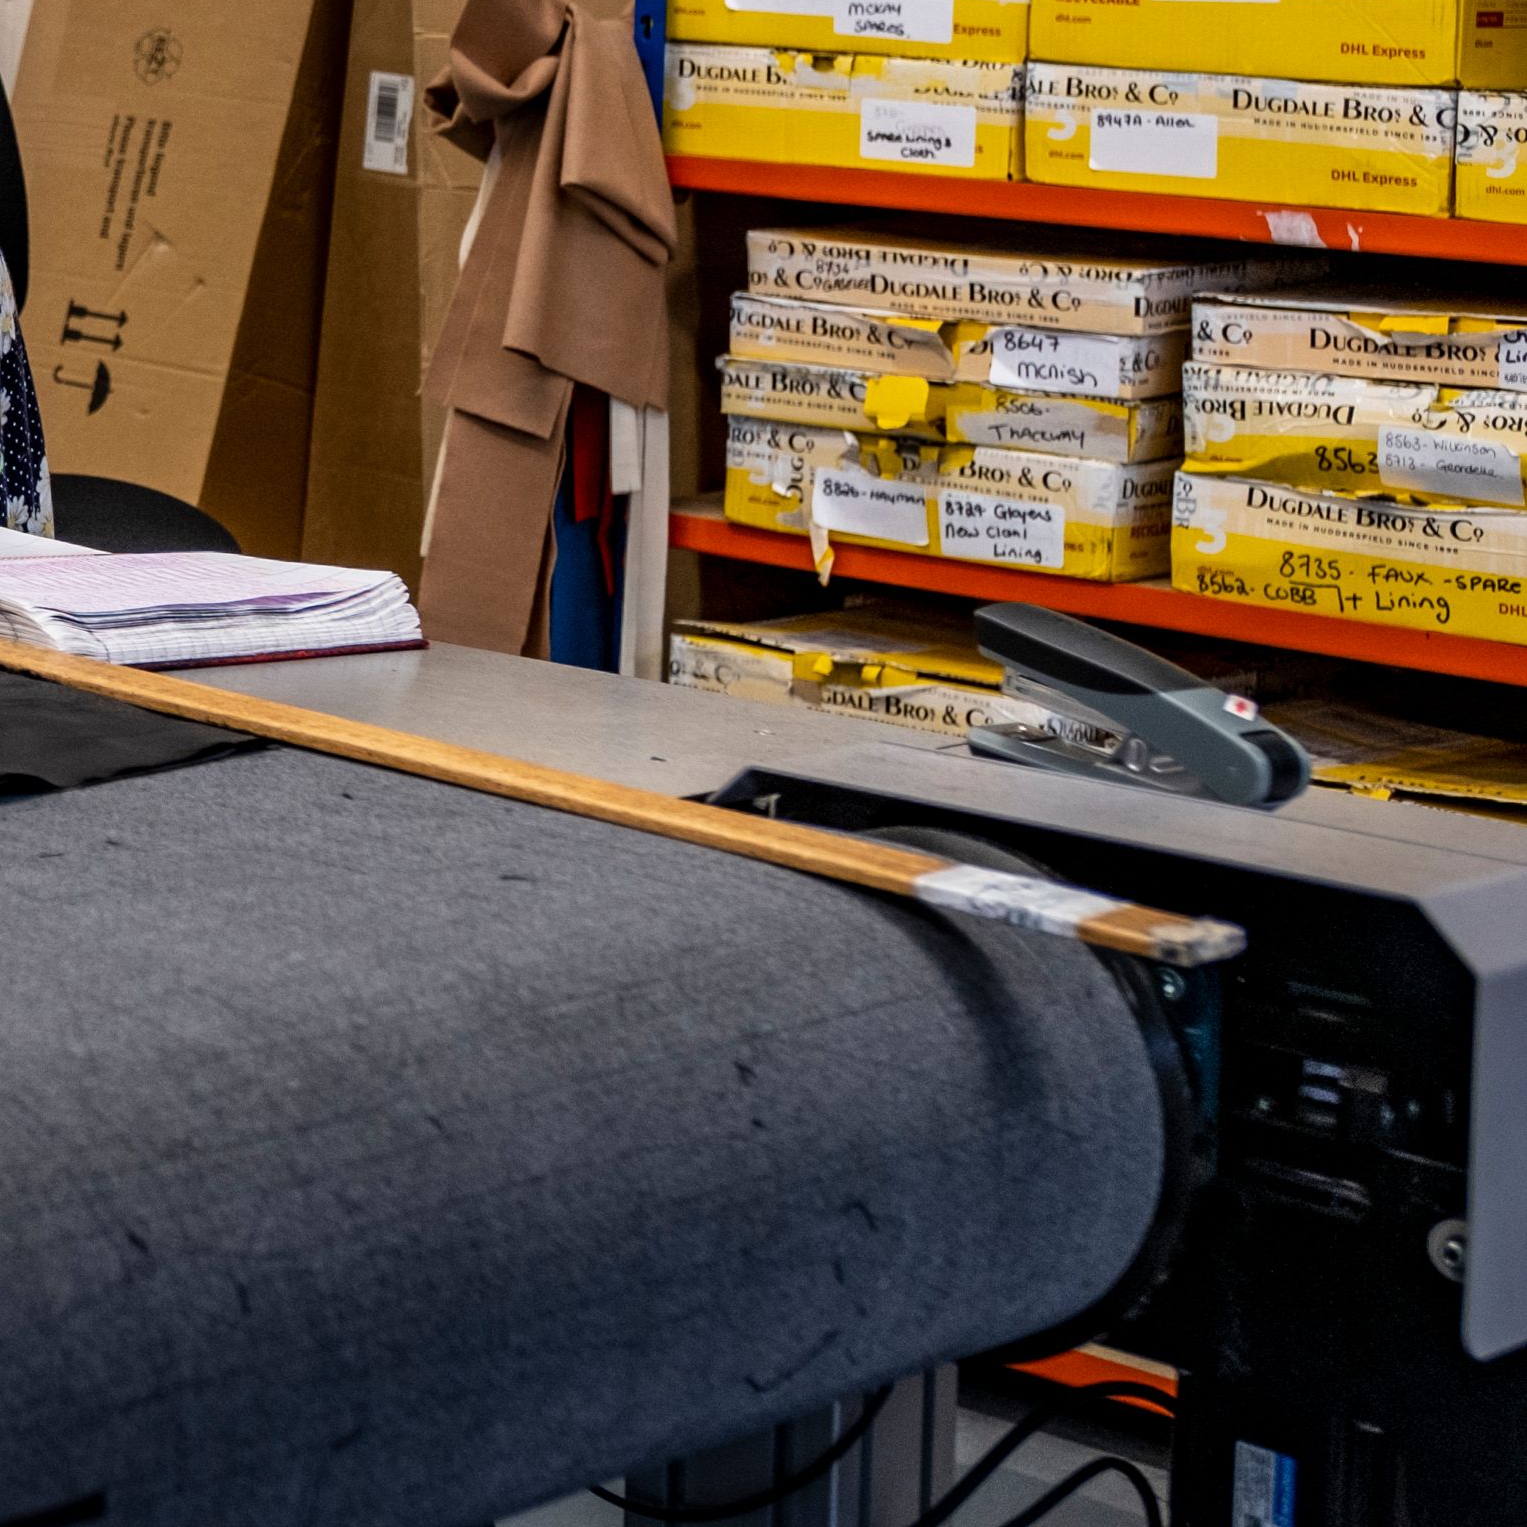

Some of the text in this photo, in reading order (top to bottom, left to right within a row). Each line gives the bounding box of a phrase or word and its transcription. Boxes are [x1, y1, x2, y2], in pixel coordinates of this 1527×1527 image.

[953, 25, 1002, 37] Express
[1340, 42, 1426, 60] DHL Express
[1124, 81, 1144, 104] &
[1408, 104, 1429, 128] &
[1331, 168, 1418, 188] DHL Express
[1485, 185, 1526, 197] dhl.com
[773, 267, 791, 288] &
[1027, 286, 1045, 309] &
[866, 322, 884, 347] &
[1003, 332, 1060, 353] 8647
[1196, 319, 1217, 343] &
[1332, 358, 1465, 376] MADE IN HUDDERSFIELD
[827, 377, 845, 401] &
[1018, 466, 1037, 490] &
[1266, 517, 1295, 529] MADE
[1299, 523, 1309, 532] IN
[1397, 539, 1430, 552] SINCE
[1422, 517, 1444, 540] &
[1367, 564, 1434, 586] FAUX
[1263, 583, 1318, 606] COBB
[1375, 591, 1451, 624] Lining
[942, 704, 960, 728] &
